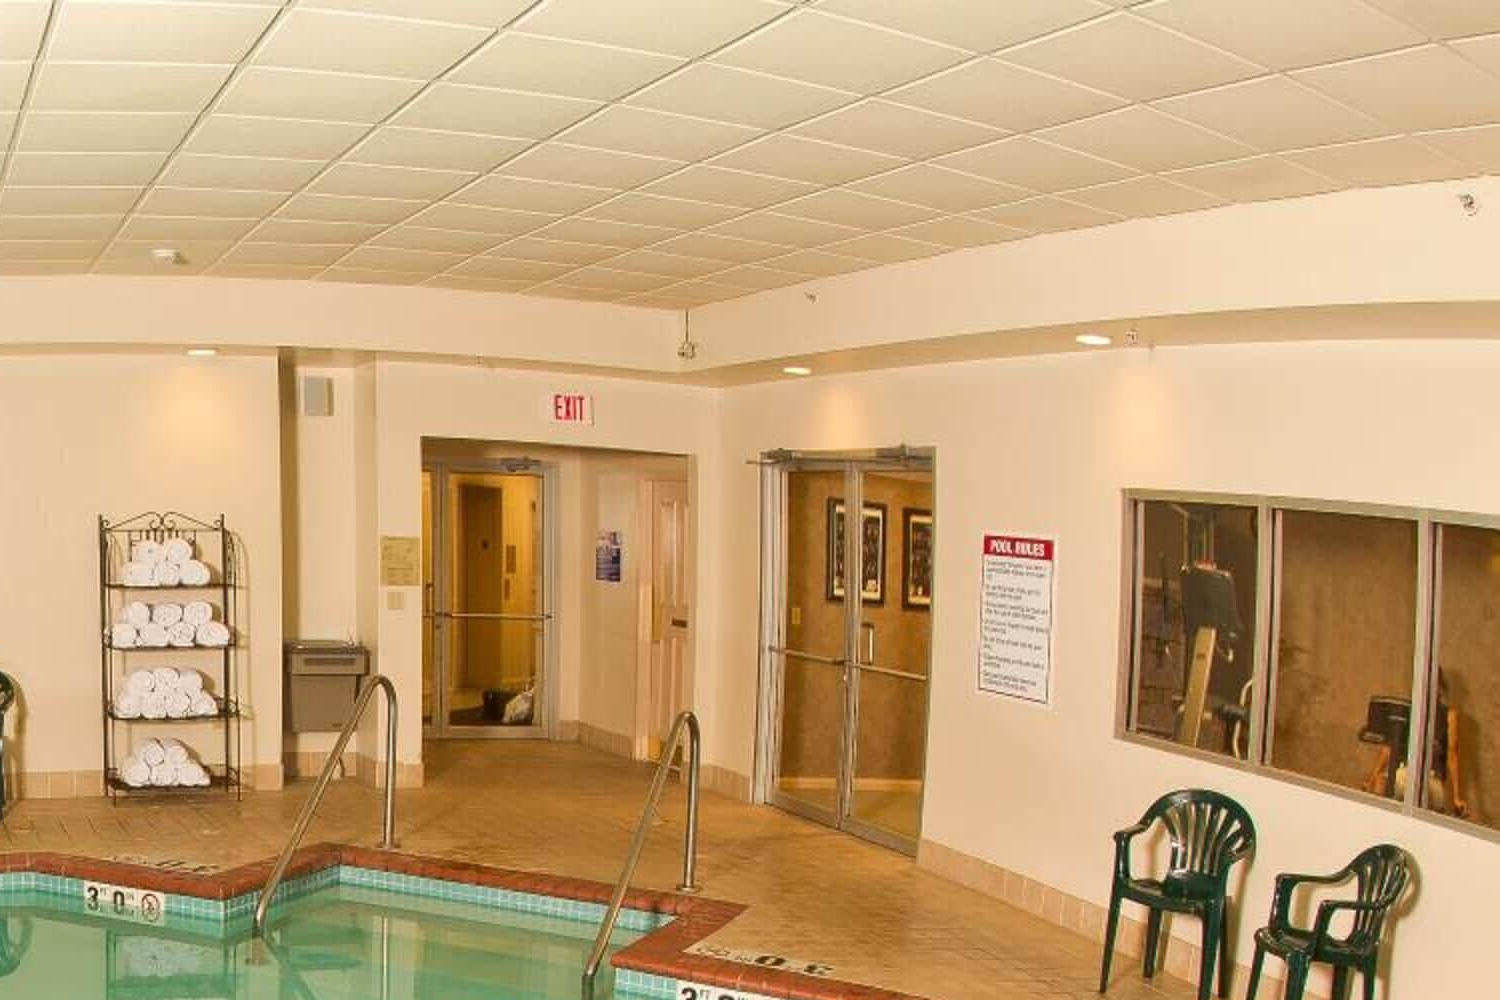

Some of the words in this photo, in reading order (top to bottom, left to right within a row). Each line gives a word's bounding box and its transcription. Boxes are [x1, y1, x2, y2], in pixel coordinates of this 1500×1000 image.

[554, 394, 584, 421] EXIT
[989, 538, 1013, 554] POOL
[1014, 540, 1045, 557] RULES
